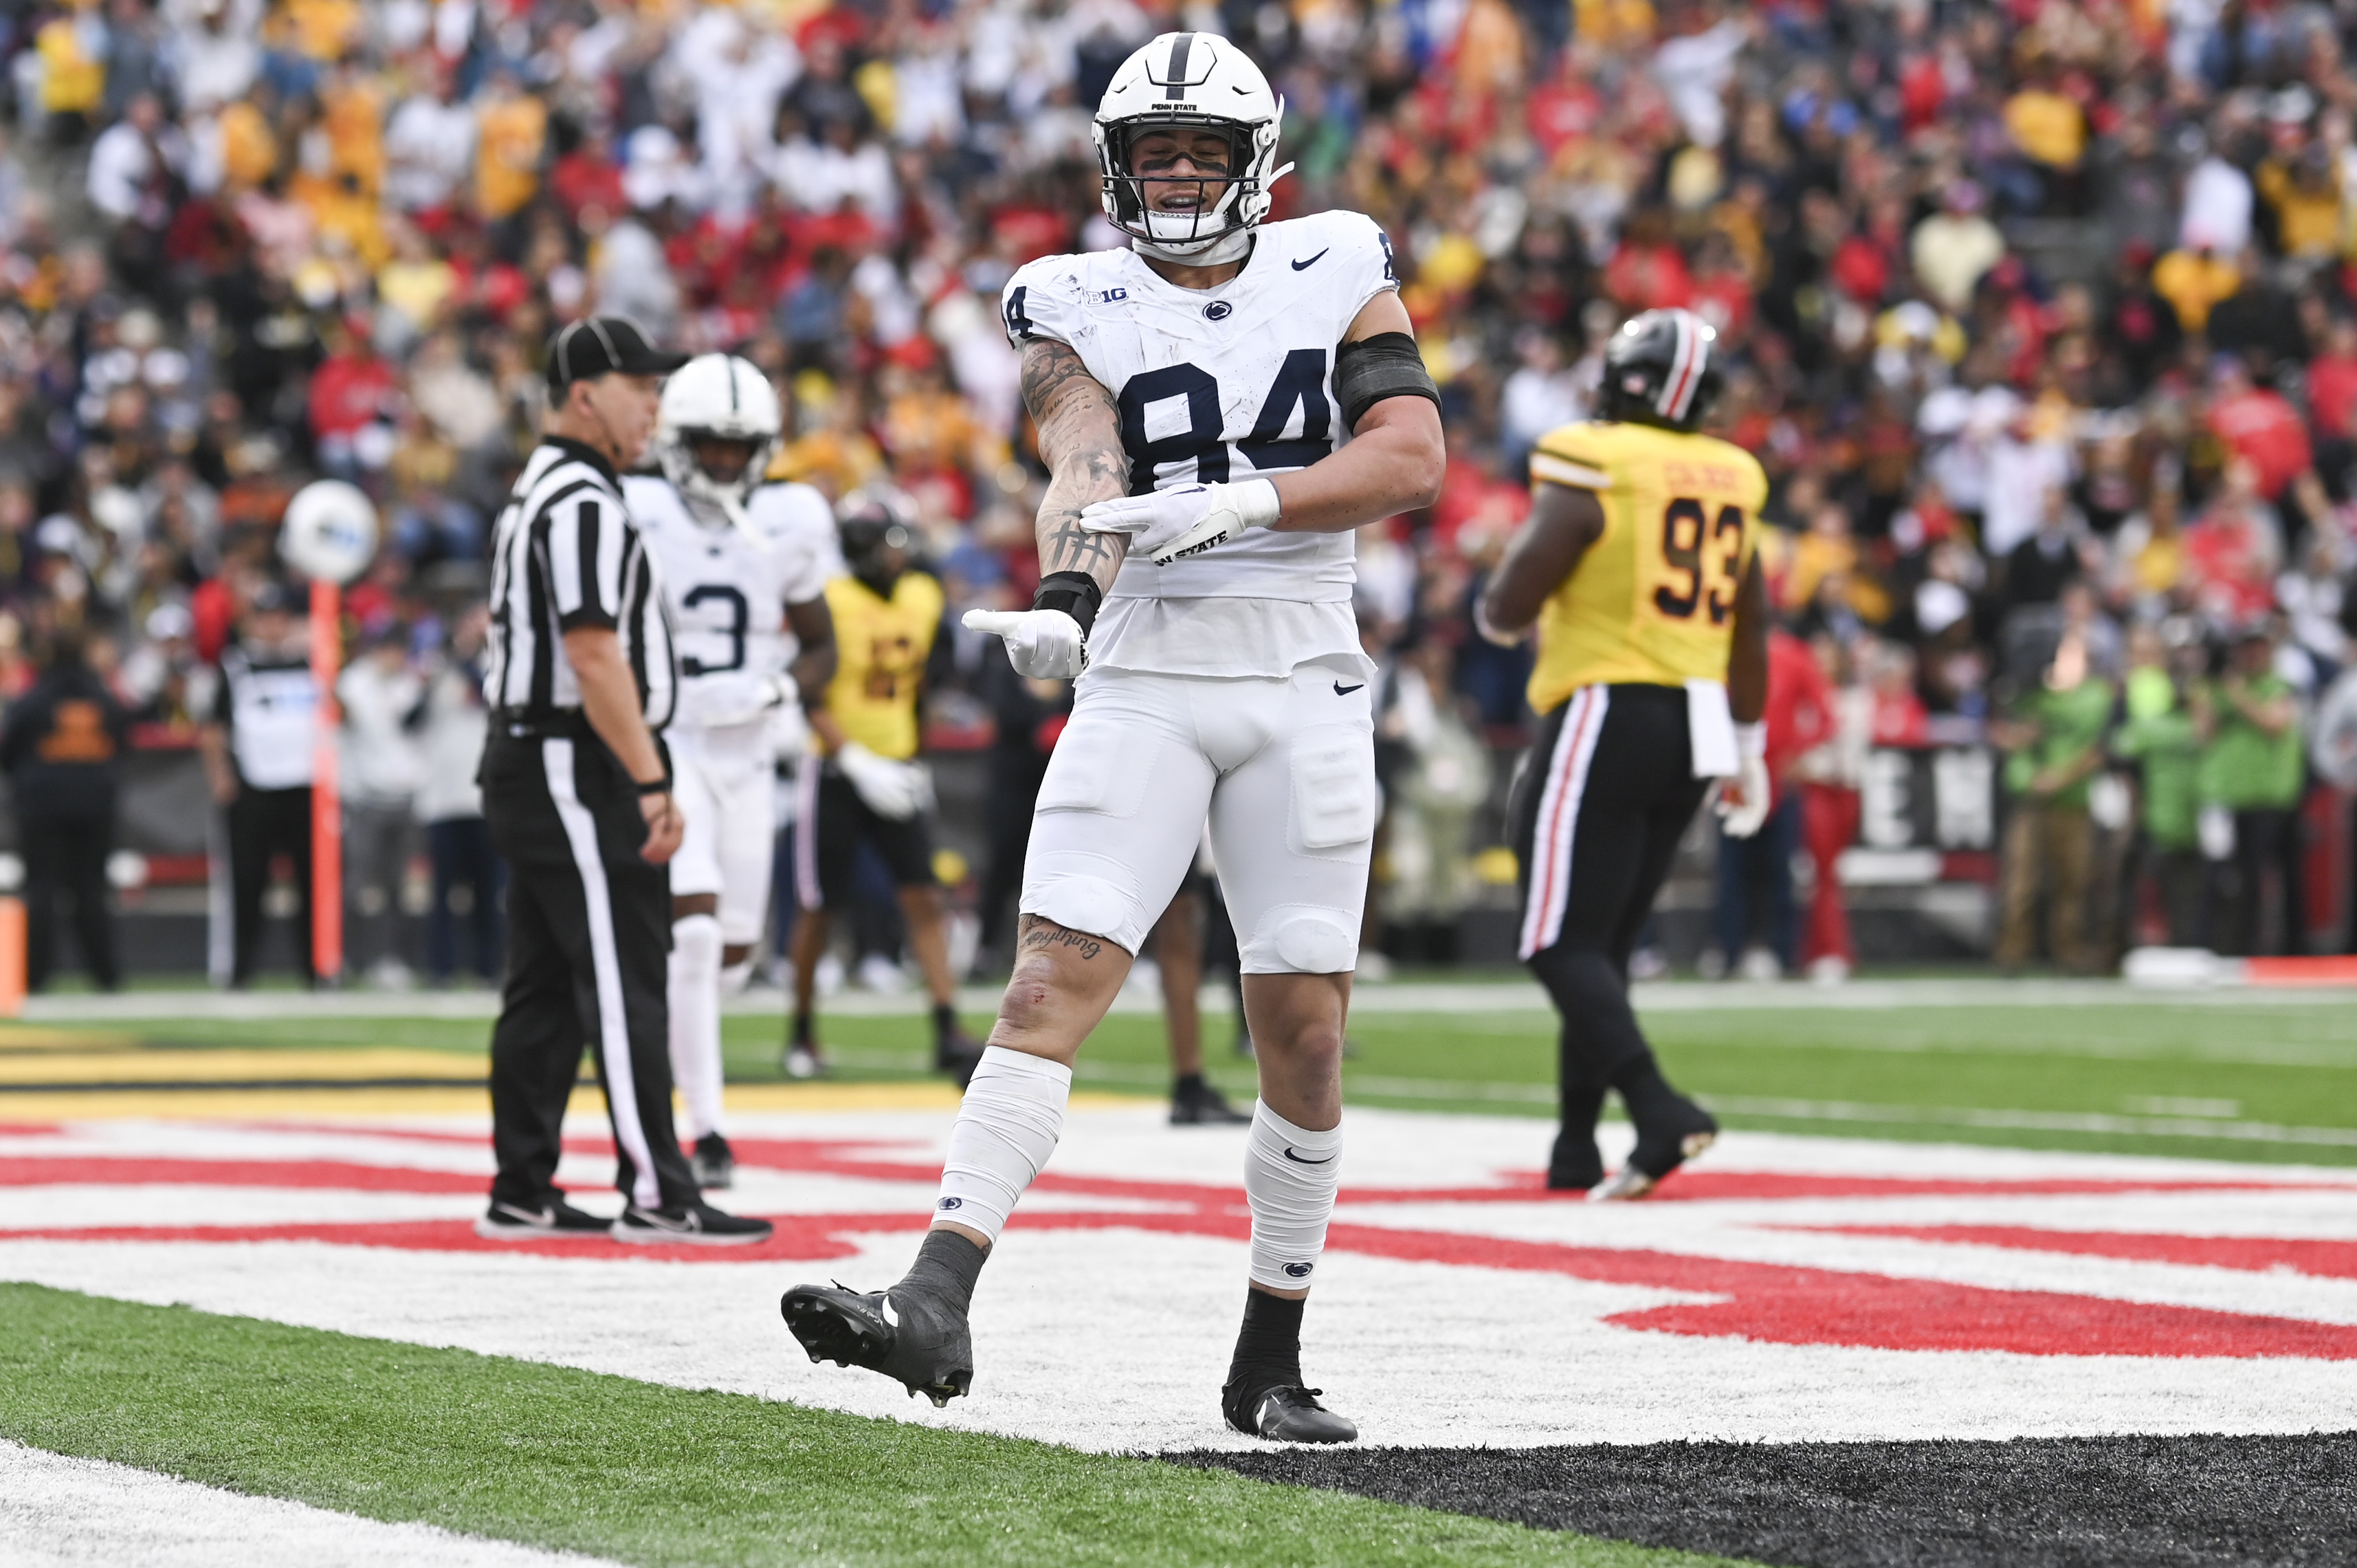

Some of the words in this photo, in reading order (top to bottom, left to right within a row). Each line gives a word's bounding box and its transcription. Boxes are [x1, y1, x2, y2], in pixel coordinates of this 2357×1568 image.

[1118, 349, 1333, 497] 84
[1174, 530, 1228, 559] STATE
[1654, 496, 1743, 624] 93
[683, 585, 747, 676] 3
